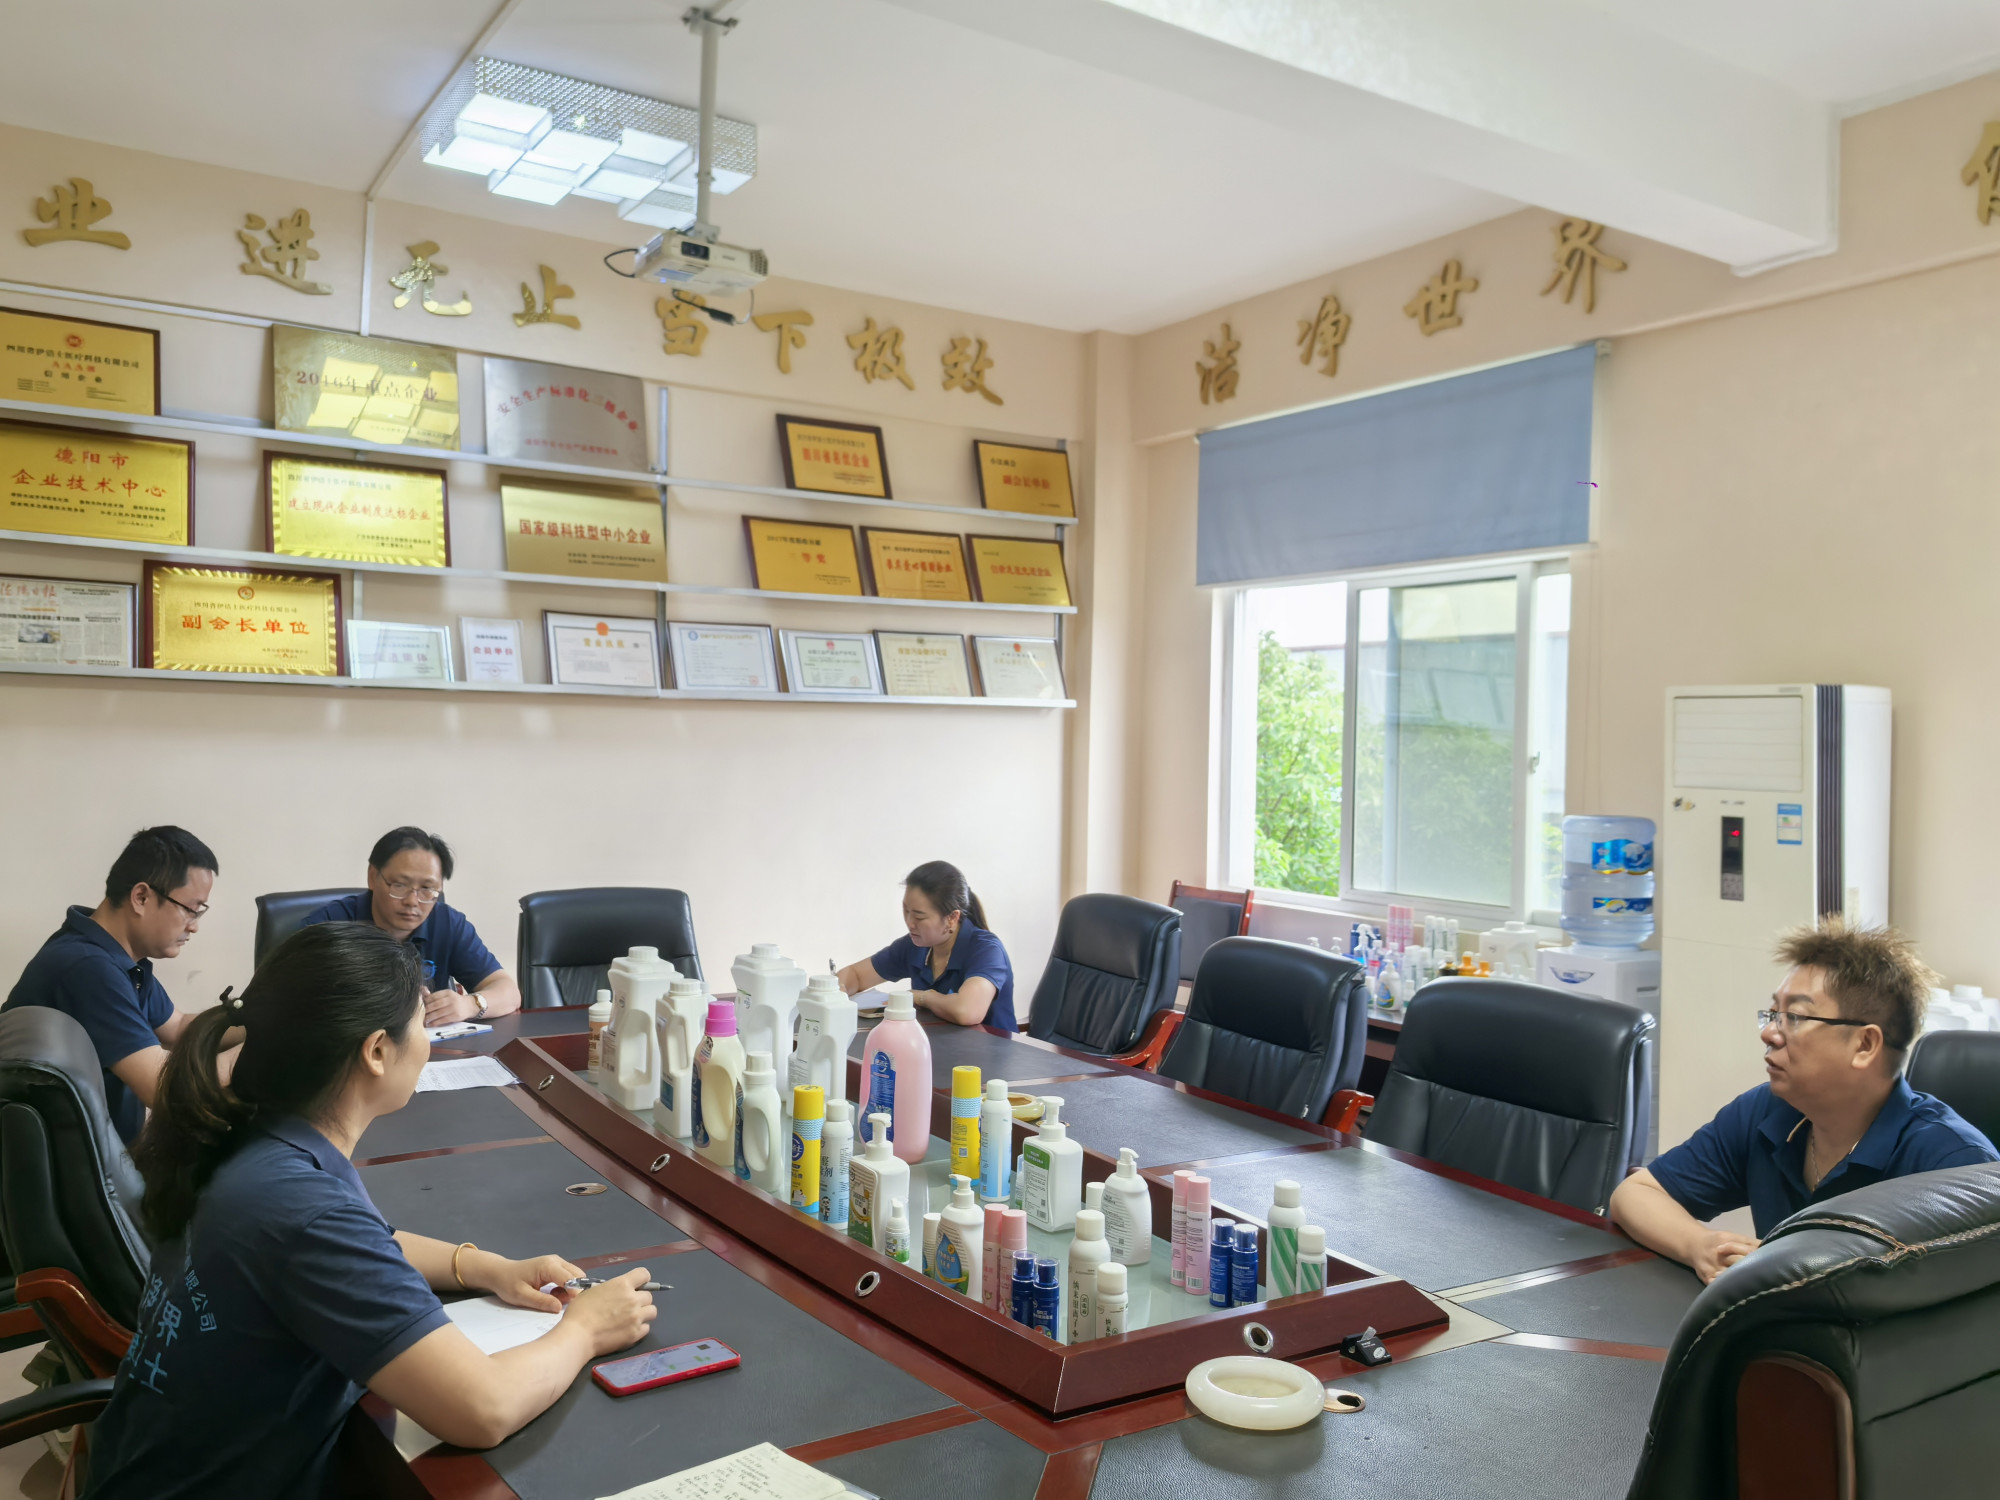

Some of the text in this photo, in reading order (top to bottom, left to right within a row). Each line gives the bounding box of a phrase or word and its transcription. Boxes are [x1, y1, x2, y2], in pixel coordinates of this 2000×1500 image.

[1195, 217, 1629, 406] 洁净世界
[55, 446, 129, 470] 德阳市
[12, 468, 167, 498] 企业技术中心
[287, 498, 432, 521] 建立现代企业制度达标企业
[519, 518, 652, 545] 国家级科技型中小企业
[181, 614, 311, 635] 副会长单位
